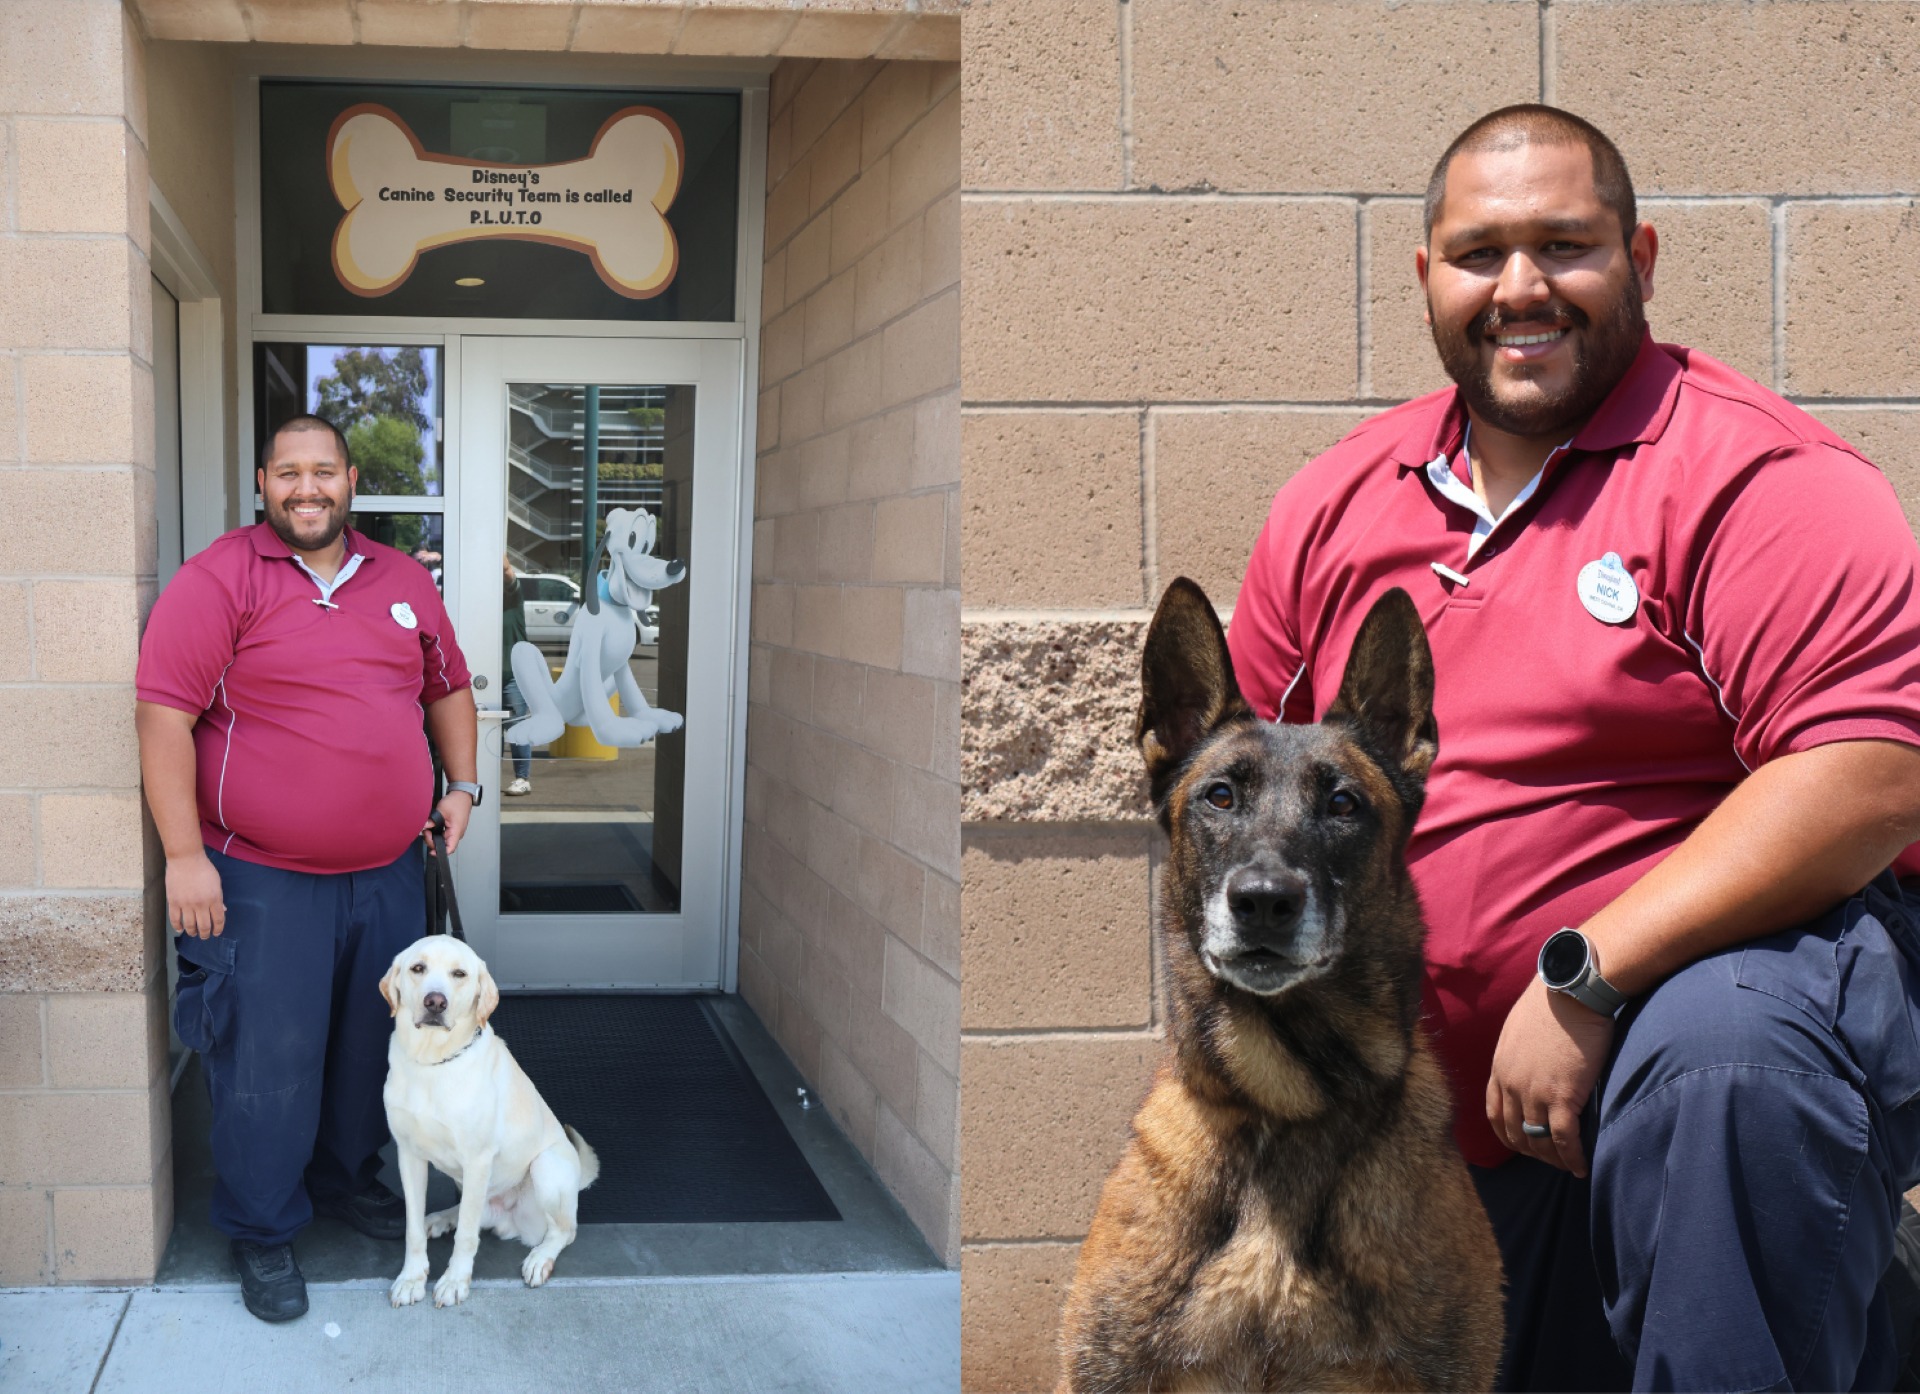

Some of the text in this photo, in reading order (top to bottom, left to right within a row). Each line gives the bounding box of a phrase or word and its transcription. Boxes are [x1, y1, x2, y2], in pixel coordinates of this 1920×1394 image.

[472, 170, 540, 188] Disney's
[378, 187, 632, 206] Canine Security Team is called
[470, 210, 542, 225] P.L.U.T.O
[1597, 583, 1619, 601] NICK
